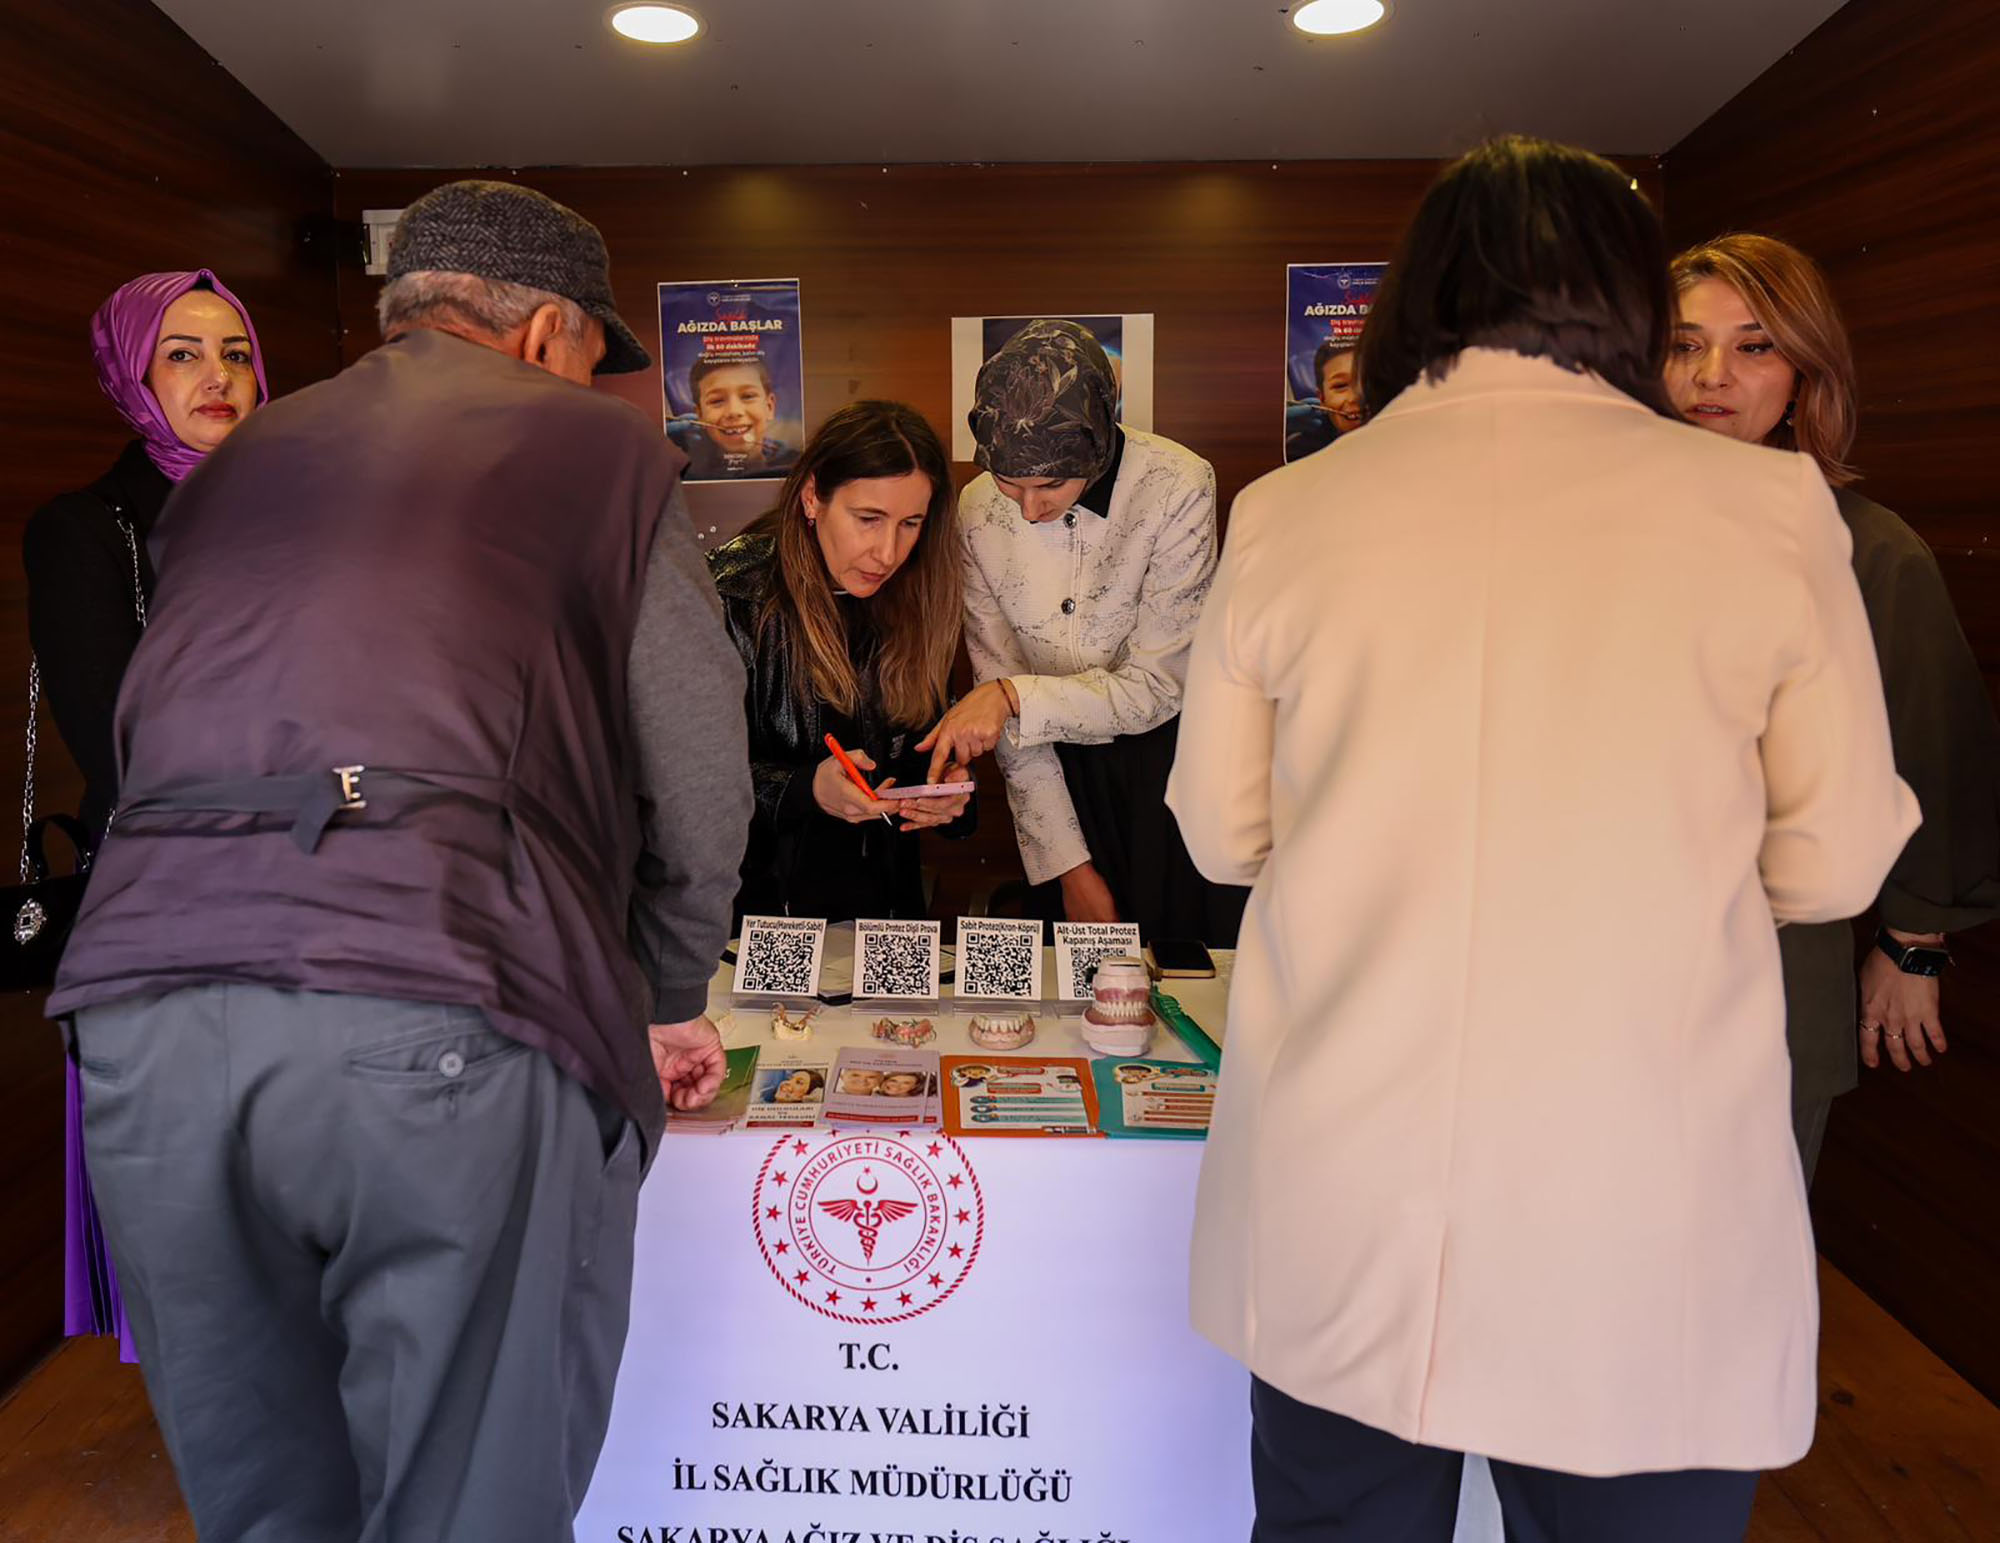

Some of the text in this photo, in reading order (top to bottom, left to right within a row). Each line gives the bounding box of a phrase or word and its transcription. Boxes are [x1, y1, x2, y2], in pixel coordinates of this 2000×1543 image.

[1304, 302, 1357, 316] AĞIZDA
[677, 319, 783, 333] AĞIZDA BAŞLAR
[885, 922, 905, 933] Protez
[920, 923, 938, 934] Prova
[960, 920, 977, 930] Sabit
[1057, 922, 1137, 936] Alt-Üst Total Protez
[1063, 936, 1132, 947] Kapanış Aşaması
[795, 1142, 941, 1276] TÜRKİYE CUMHURİYETİ SAĞLIK BAKANLIĞI
[839, 1343, 899, 1371] T.C.
[712, 1402, 1029, 1438] SAKARYA VALİLİĞİ
[673, 1457, 1071, 1503] İL SAĞLIK MÜDÜRLÜĞÜ
[617, 1526, 768, 1543] SAKARYA
